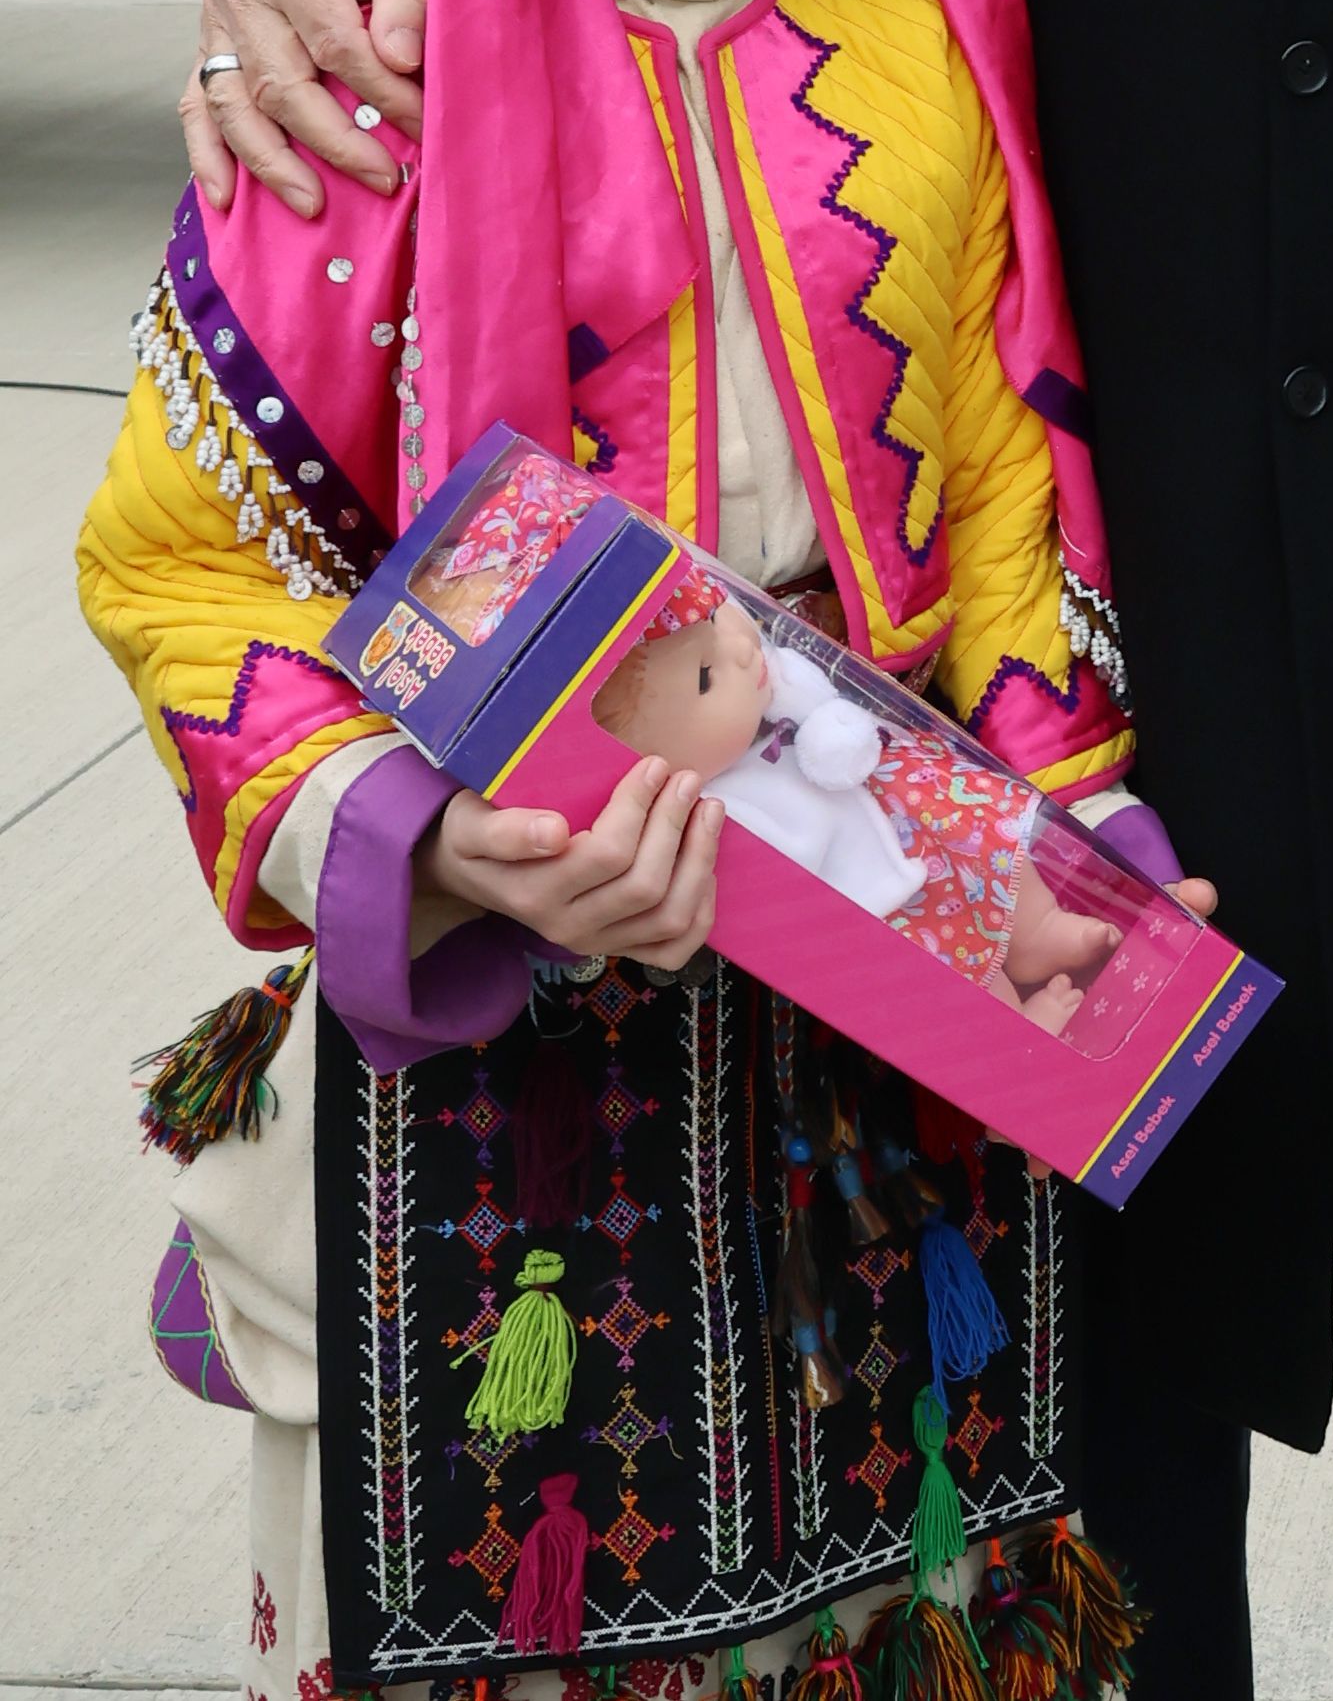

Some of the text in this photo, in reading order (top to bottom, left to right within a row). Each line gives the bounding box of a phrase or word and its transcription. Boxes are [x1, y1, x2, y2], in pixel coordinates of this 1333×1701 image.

[374, 656, 427, 710] Asel
[402, 619, 456, 679] Bebek
[1193, 983, 1257, 1067] Asel Bebek
[1111, 1095, 1176, 1179] Asel Bebek
